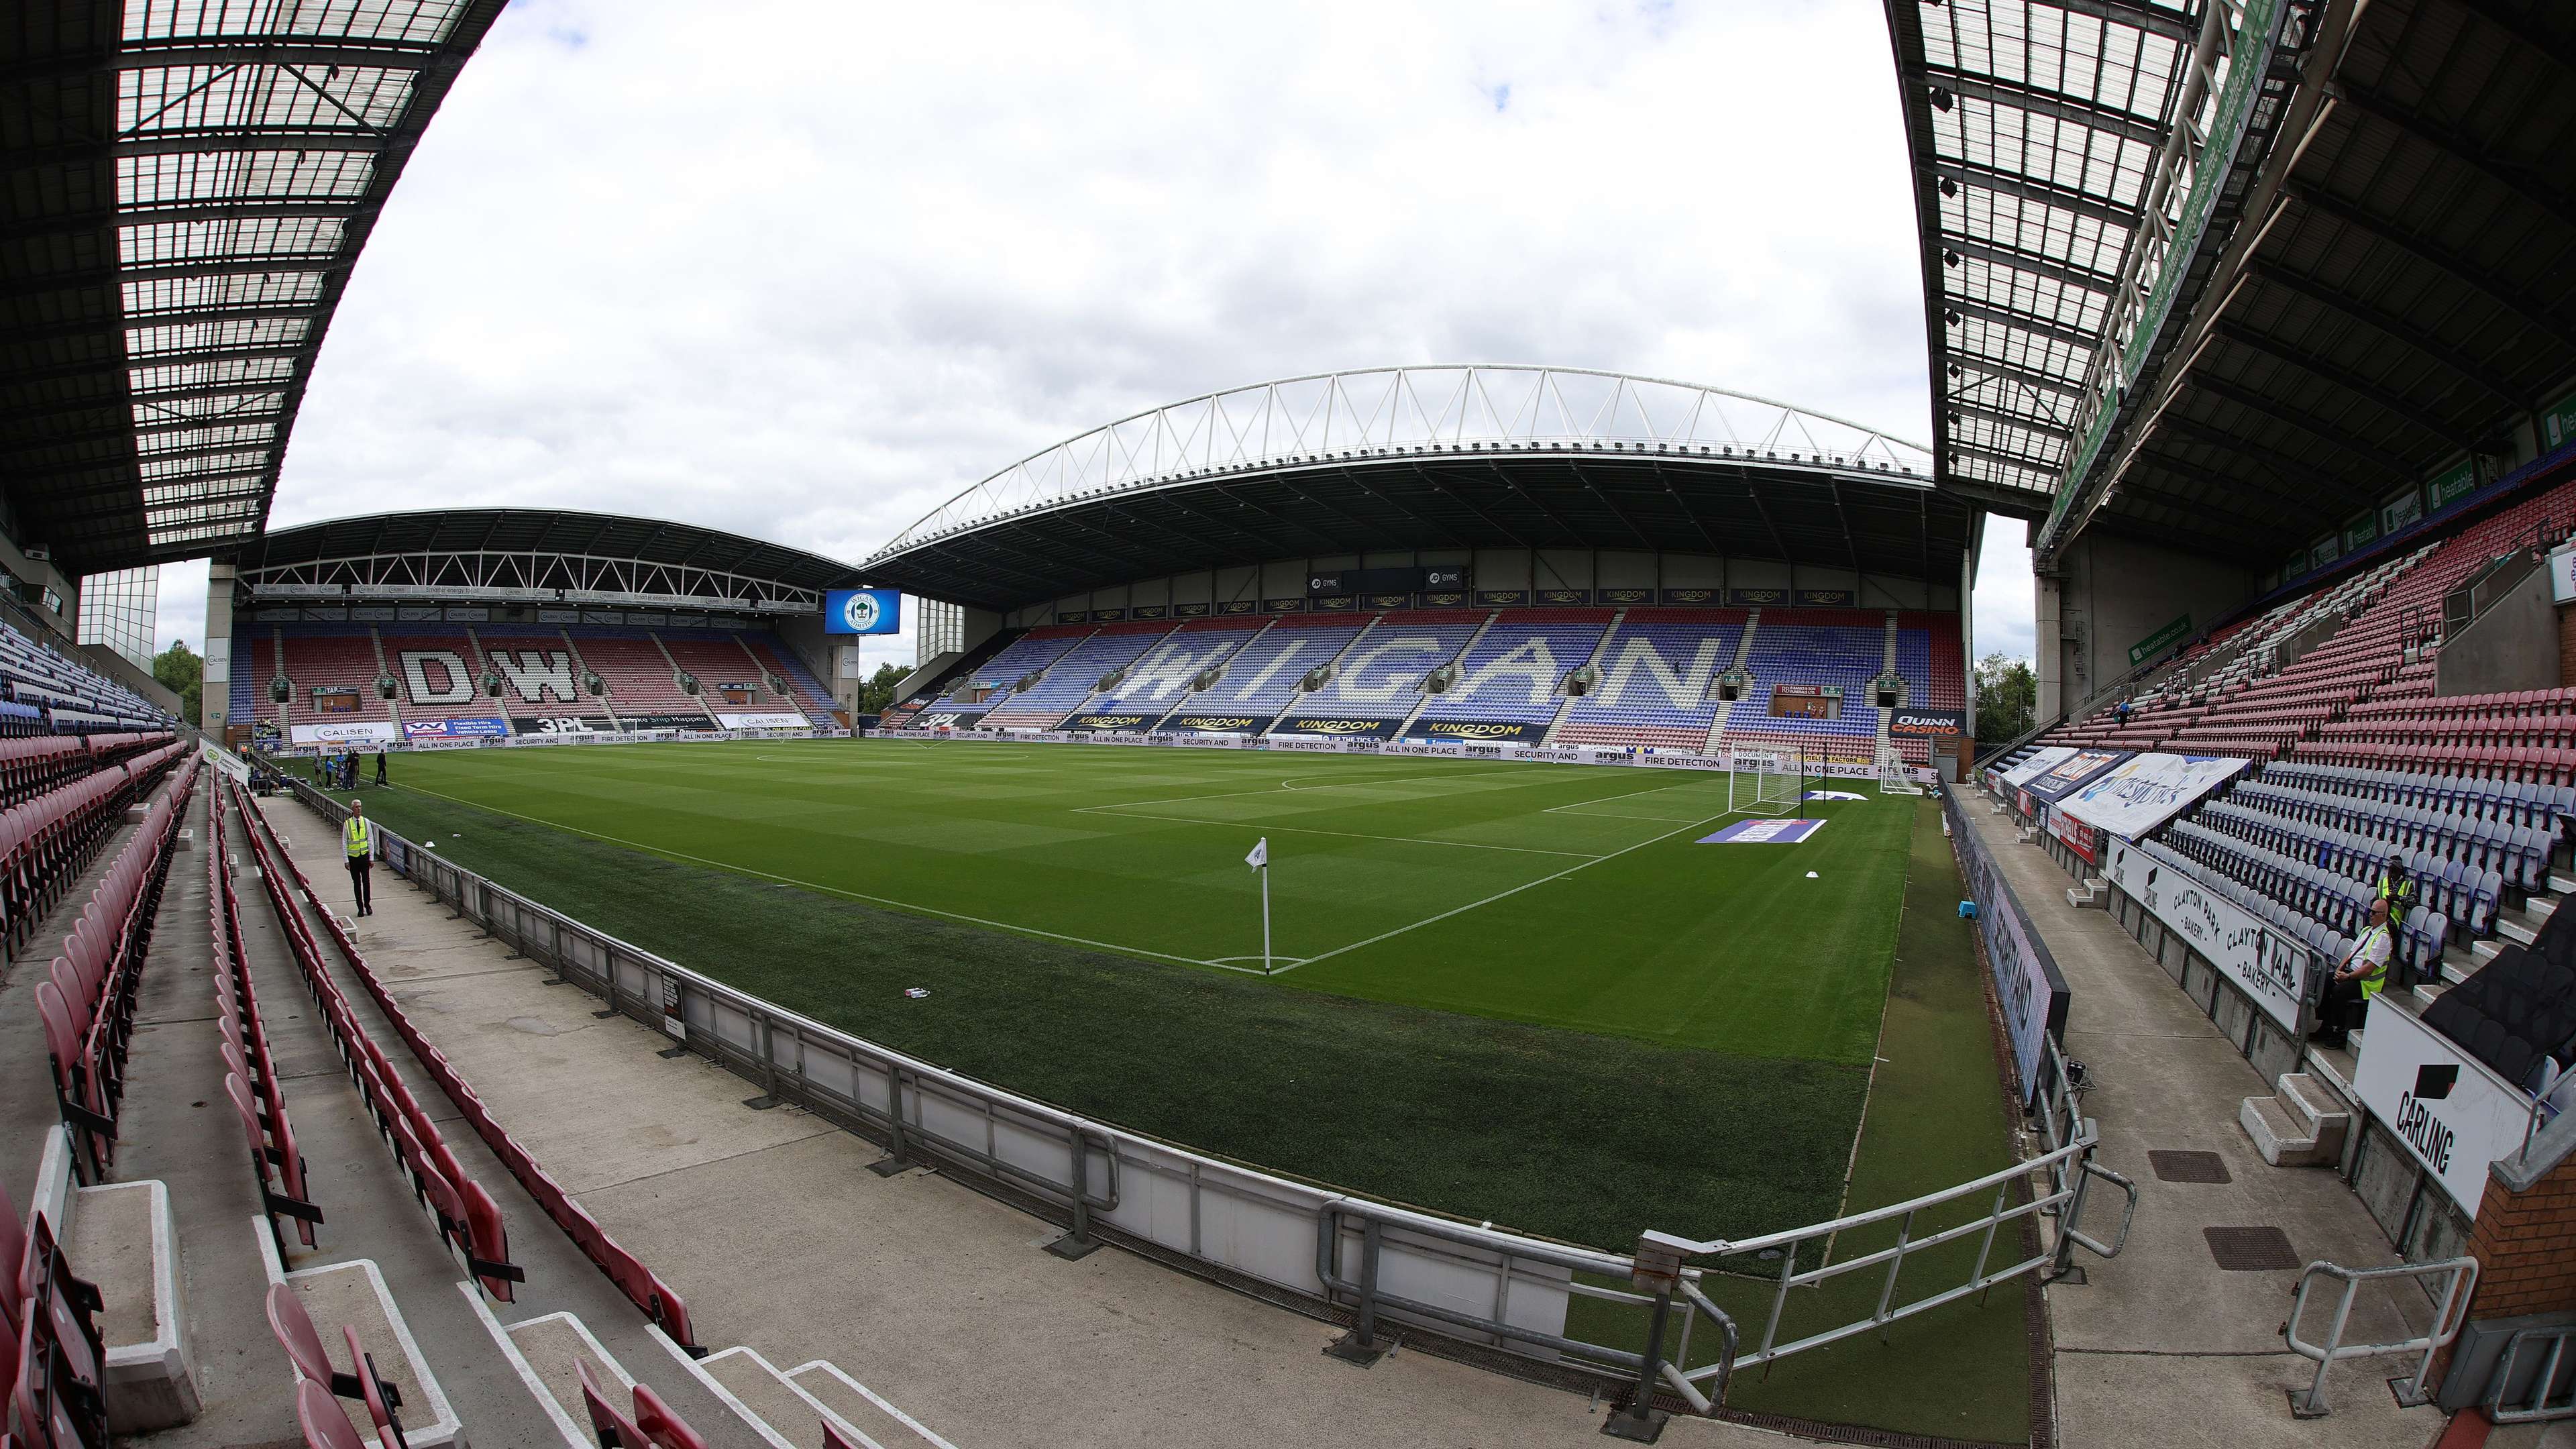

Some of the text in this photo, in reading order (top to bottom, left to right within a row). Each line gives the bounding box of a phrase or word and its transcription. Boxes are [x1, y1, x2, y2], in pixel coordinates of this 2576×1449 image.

[2218, 35, 2256, 141] heatable.co.uk
[2440, 471, 2473, 500] heatable
[851, 595, 873, 604] WIGAN
[1427, 594, 1462, 602] KINGDOM
[1804, 591, 1845, 599] KINGDOM
[1180, 604, 1206, 612] KINGDOM
[1269, 599, 1299, 607] KINGDOM
[849, 620, 873, 629] ATHLETIC
[2141, 622, 2188, 655] heatable.co.uk
[537, 717, 593, 733] 3PL
[920, 714, 961, 727] 3PL
[1078, 716, 1142, 724] KINGDOM
[1179, 718, 1253, 727] KINGDOM
[1295, 720, 1381, 730] KINGDOM
[1897, 716, 1955, 727] QUINN
[323, 728, 373, 737] CALISEN
[1429, 722, 1523, 735] KINGDOM
[1891, 724, 1960, 735] CASINO
[343, 744, 378, 753] DETECTION
[1347, 741, 1379, 749] argus
[1465, 745, 1501, 754] argus
[1514, 750, 1556, 759] SECURITY
[1595, 752, 1634, 761] argus
[220, 756, 241, 771] Greenmount
[1645, 757, 1720, 767] FIRE DETECTION
[1734, 759, 1775, 767] argus
[1815, 765, 1835, 773] ONE
[1838, 766, 1868, 775] PLACE
[2143, 885, 2157, 911] CARLING
[2174, 889, 2220, 943] CLAYTON PARK
[2184, 918, 2204, 943] BAKERY
[2226, 926, 2269, 957] CLAYTON
[2241, 960, 2271, 996] BAKERY
[2012, 958, 2033, 1031] AND
[2396, 1090, 2453, 1176] CARLING
